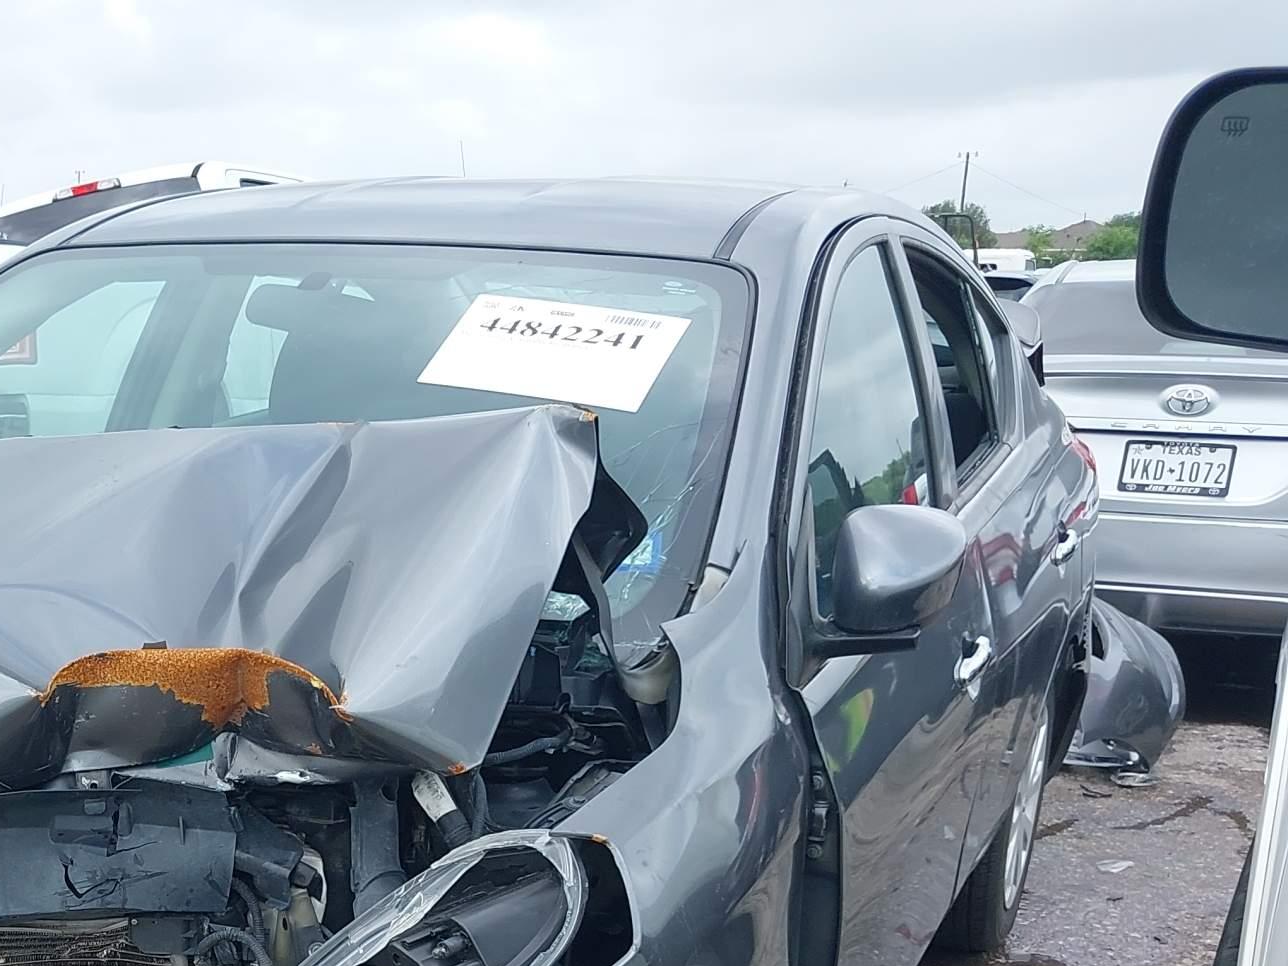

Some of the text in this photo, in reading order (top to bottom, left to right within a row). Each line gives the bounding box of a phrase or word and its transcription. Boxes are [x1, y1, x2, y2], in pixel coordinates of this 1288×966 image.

[480, 317, 644, 349] 44842241
[1110, 421, 1262, 434] CAMRY
[1161, 445, 1202, 457] TEXAS
